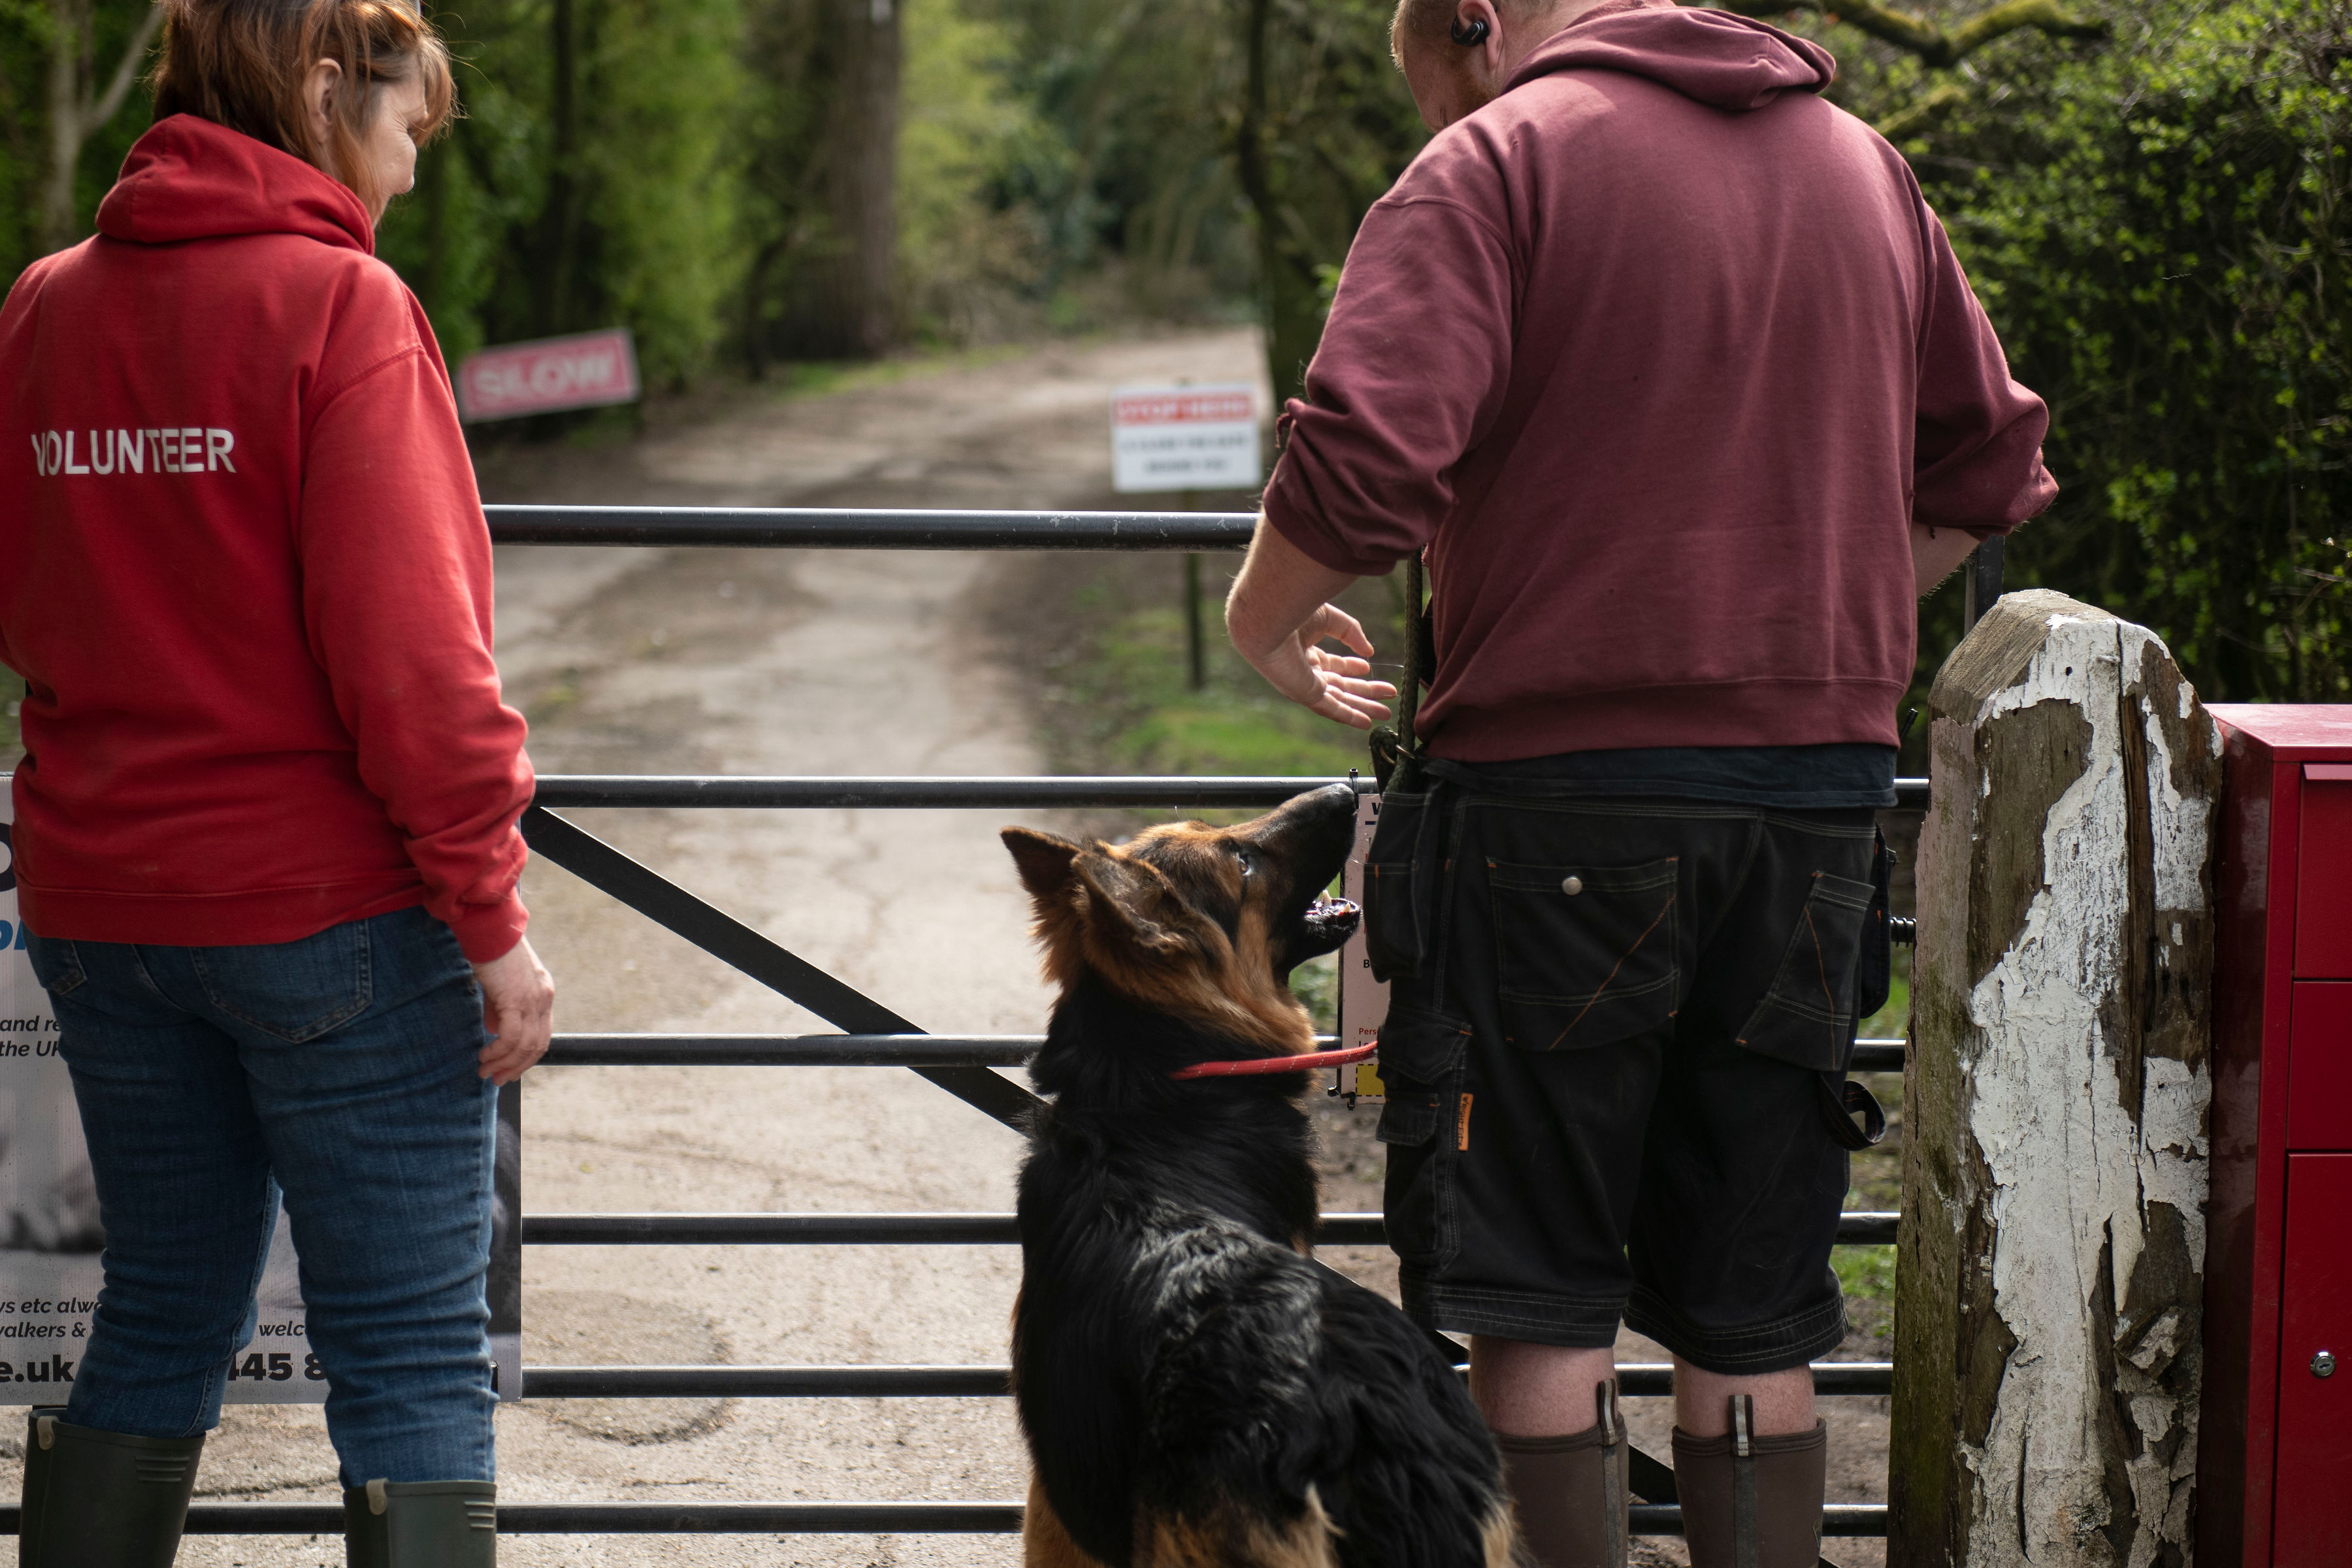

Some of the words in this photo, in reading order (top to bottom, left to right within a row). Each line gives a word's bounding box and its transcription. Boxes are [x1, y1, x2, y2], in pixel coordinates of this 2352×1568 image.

[474, 350, 615, 406] SLOW
[31, 428, 237, 476] VOLUNTEER
[0, 1015, 40, 1032] and
[0, 1040, 30, 1056] the
[20, 1298, 52, 1313] etc
[71, 1322, 86, 1337] &
